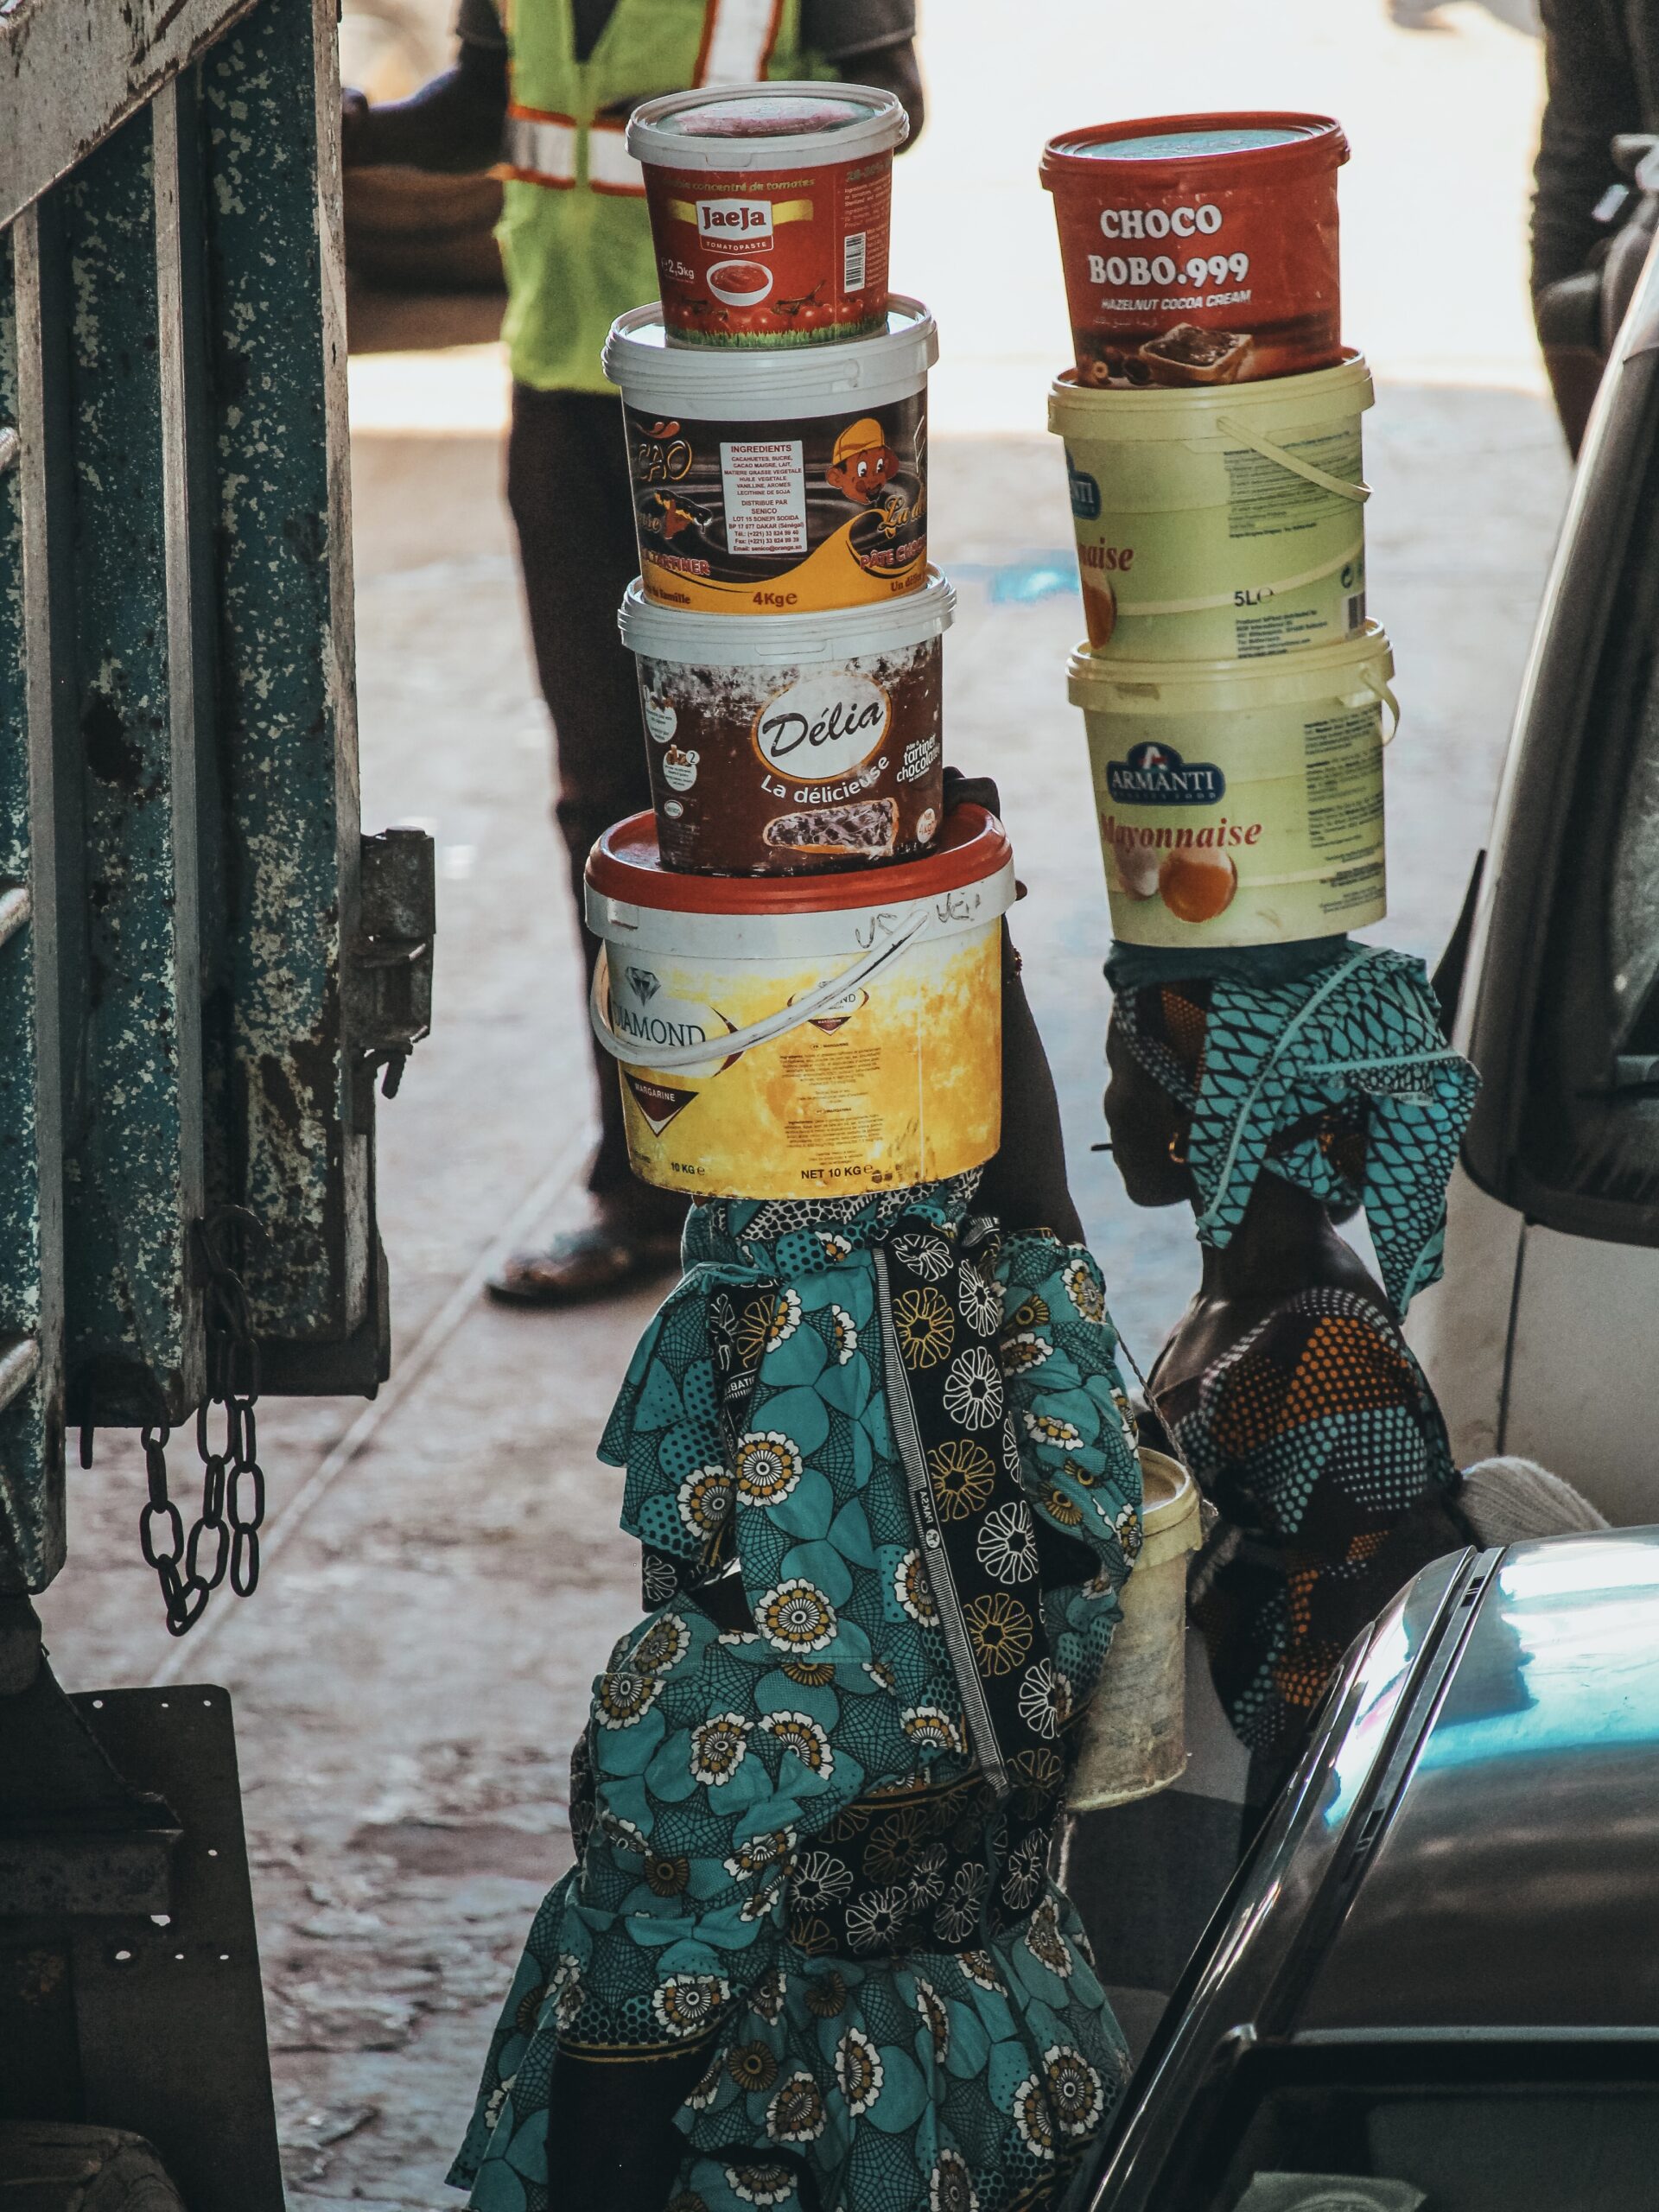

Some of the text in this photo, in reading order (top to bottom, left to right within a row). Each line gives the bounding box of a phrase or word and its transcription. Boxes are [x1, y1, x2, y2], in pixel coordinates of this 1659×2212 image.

[750, 181, 764, 191] de
[766, 177, 817, 189] tomates
[701, 206, 766, 232] JaeJa
[1099, 204, 1223, 238] CHOCO
[707, 240, 767, 251] TOMATOPASTE
[1087, 252, 1249, 288] BOBO.999
[1102, 289, 1252, 311] HAZELNUT COCOA CREAM
[731, 444, 792, 453] INGREDIENTS
[761, 700, 884, 758] Délia
[761, 774, 786, 798] La
[794, 755, 890, 804] délicieuse
[1112, 770, 1215, 791] ARMANTI
[634, 1083, 676, 1103] MARGARINE
[671, 1162, 681, 1173] 10
[682, 1164, 696, 1175] KG
[800, 1169, 826, 1180] NET
[828, 1167, 842, 1179] 10
[844, 1166, 861, 1177] KG
